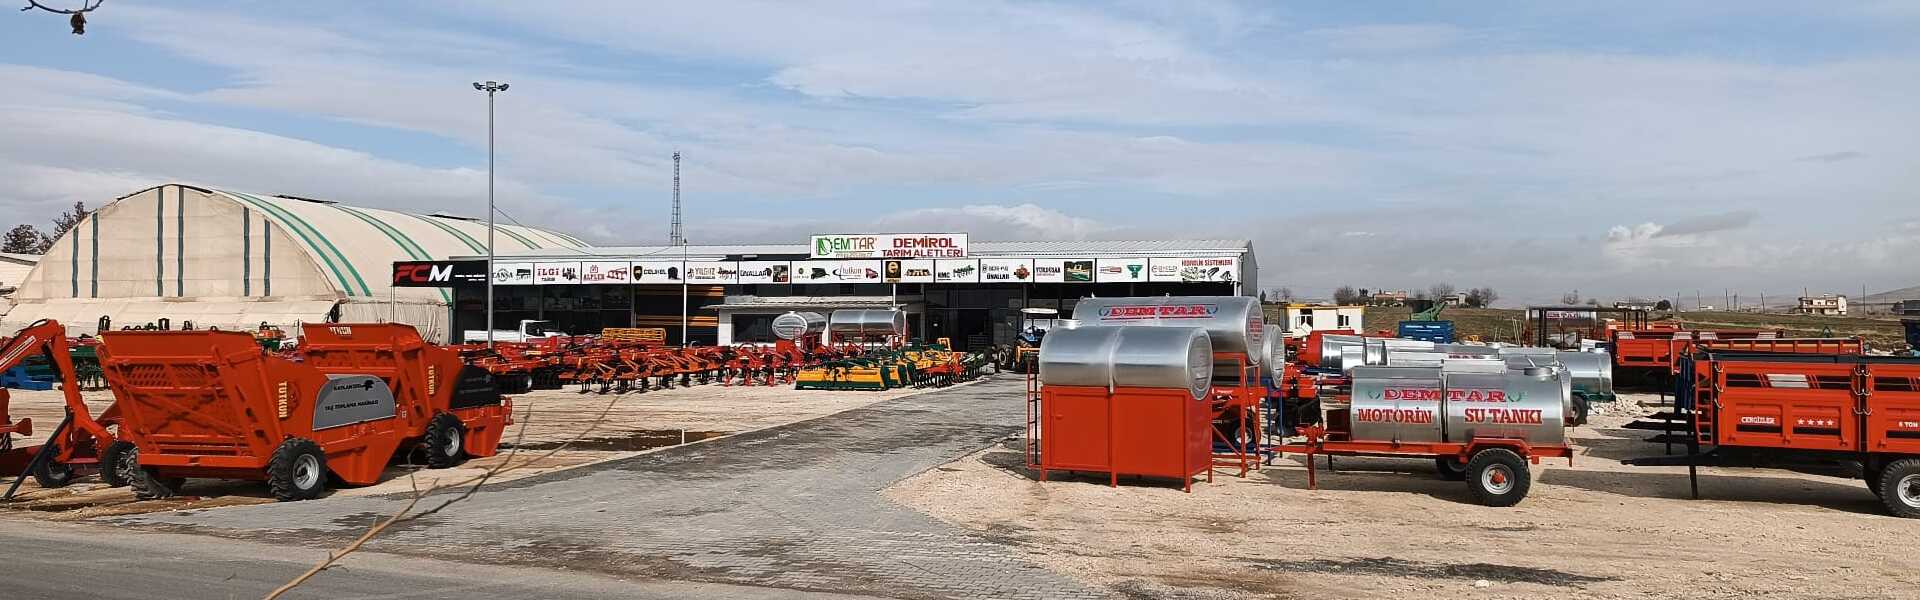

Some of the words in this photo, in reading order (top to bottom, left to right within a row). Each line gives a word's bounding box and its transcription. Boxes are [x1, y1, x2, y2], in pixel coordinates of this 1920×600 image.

[893, 236, 958, 248] DEMİROL
[881, 249, 911, 257] TARIM
[914, 248, 963, 257] ALETLERİ
[394, 264, 453, 282] FCM
[427, 364, 436, 395] TUTKUN
[278, 381, 289, 418] TUTKUN
[1384, 388, 1506, 402] DEMTAR
[1358, 406, 1432, 423] MOTORİN
[1464, 408, 1486, 423] SU
[1488, 408, 1542, 424] TANKI
